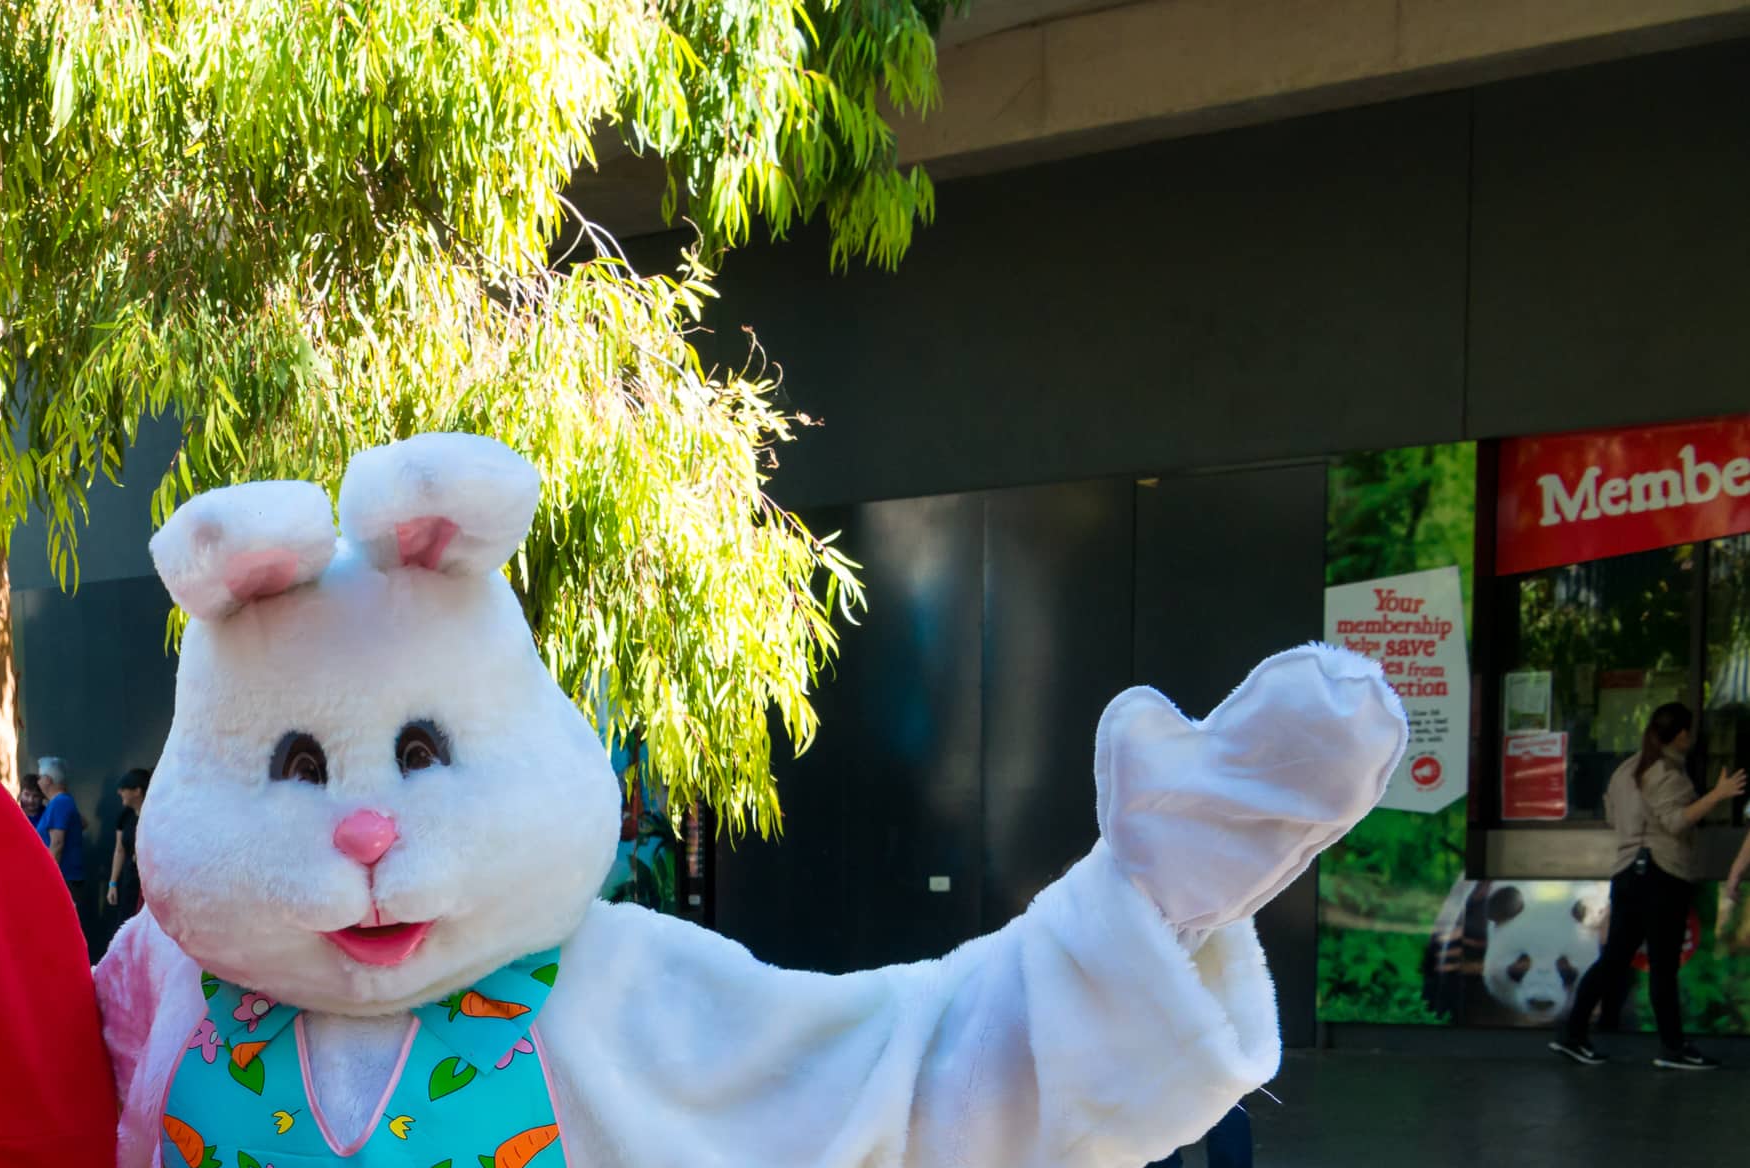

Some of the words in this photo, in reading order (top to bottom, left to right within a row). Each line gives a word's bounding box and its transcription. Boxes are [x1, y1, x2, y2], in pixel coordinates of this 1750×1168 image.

[1537, 444, 1750, 527] Membe
[1373, 588, 1426, 614] Your
[1336, 614, 1453, 641] membership
[1385, 638, 1437, 657] save
[1407, 661, 1445, 678] from
